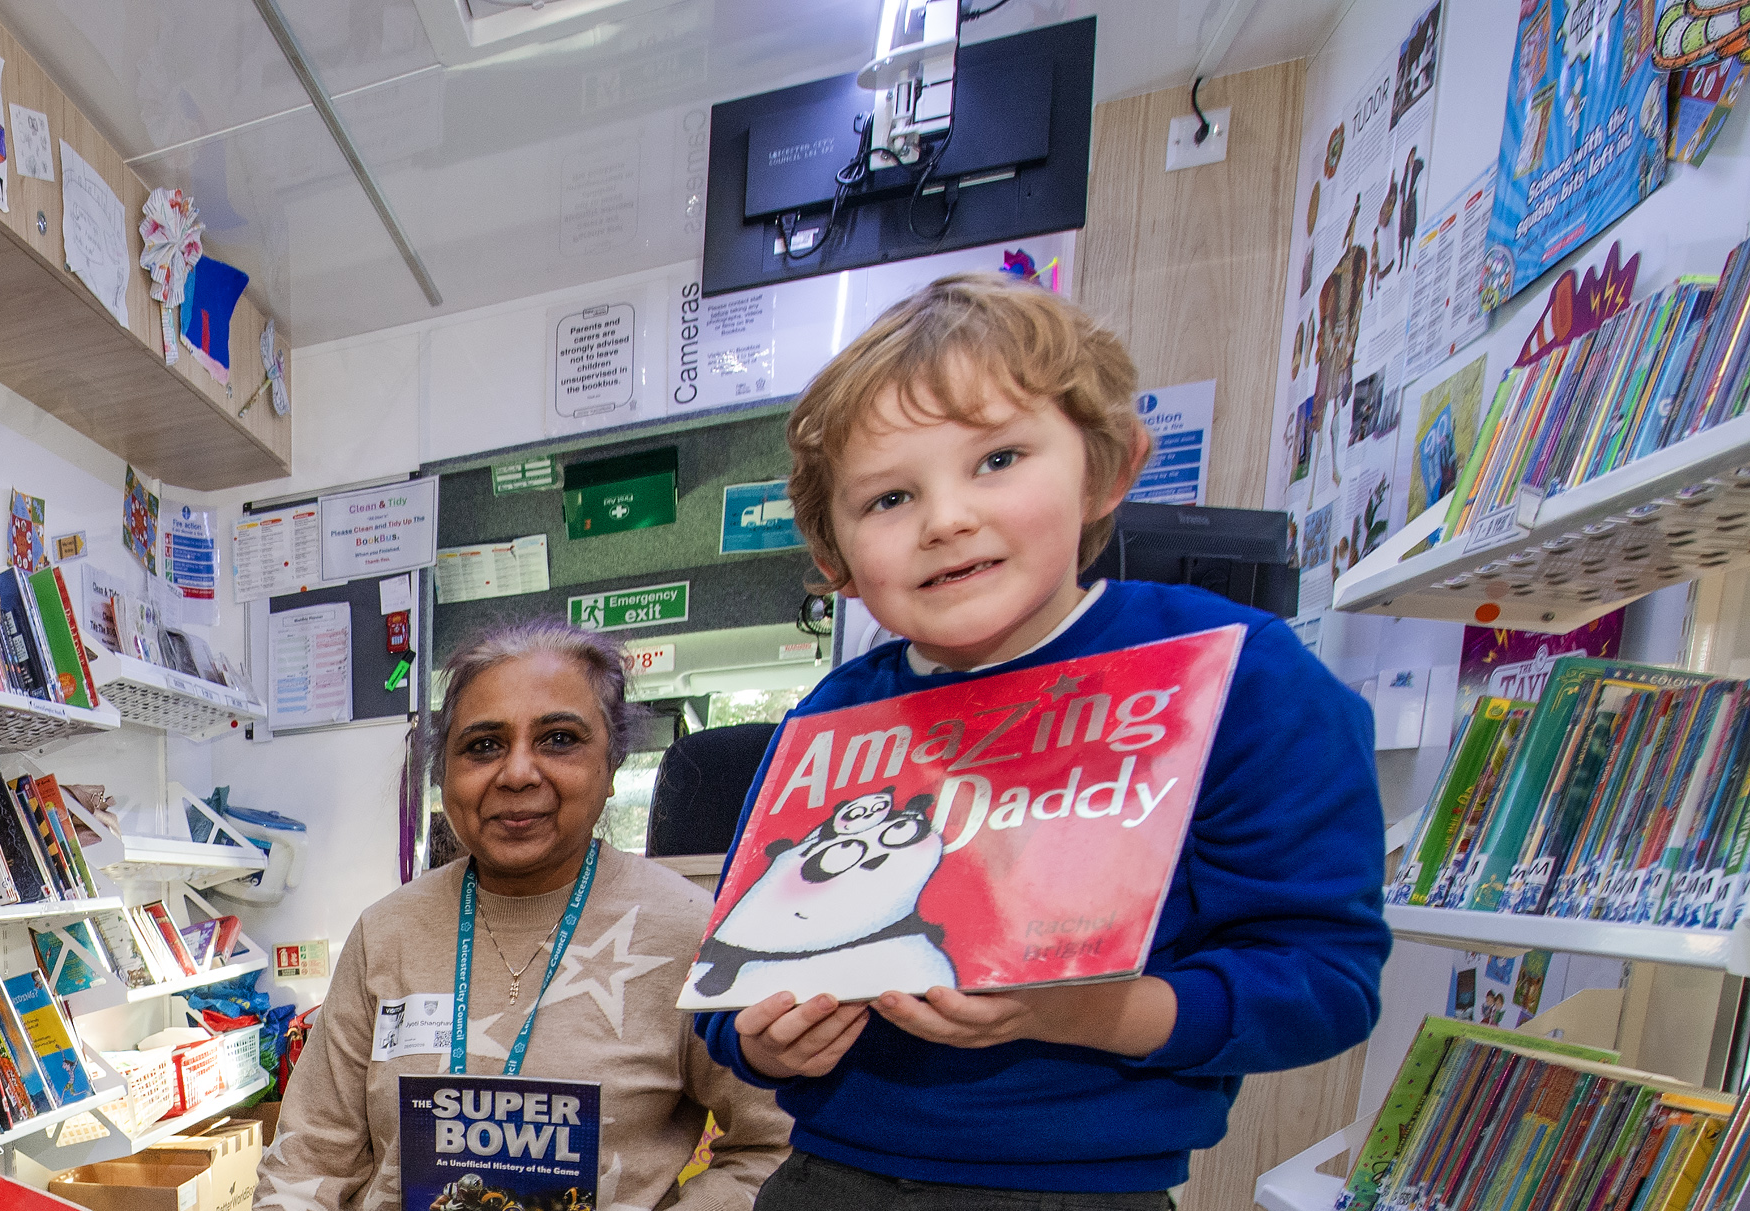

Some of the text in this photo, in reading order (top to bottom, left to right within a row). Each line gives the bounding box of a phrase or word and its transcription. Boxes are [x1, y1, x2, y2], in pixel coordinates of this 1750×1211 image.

[1352, 77, 1390, 139] TUDOR
[1527, 104, 1629, 207] Science with the
[570, 317, 621, 335] Parents and
[560, 336, 630, 356] strongly advised
[574, 330, 616, 344] carers are
[674, 282, 699, 405] Cameras
[570, 355, 584, 365] not
[597, 349, 619, 358] leave
[577, 360, 611, 373] children
[560, 368, 617, 386] unsupervised
[567, 385, 580, 394] the
[349, 497, 407, 514] Clean & Tidy
[610, 589, 678, 607] Emergency
[625, 604, 661, 623] exit
[930, 755, 1180, 857] Daddy
[570, 862, 594, 909] Leicester
[456, 938, 471, 1041] Leicester City Council
[412, 1088, 581, 1126] THE SUPER
[435, 1119, 581, 1163] BOWL
[436, 1158, 580, 1177] An Unofficial History of the Game
